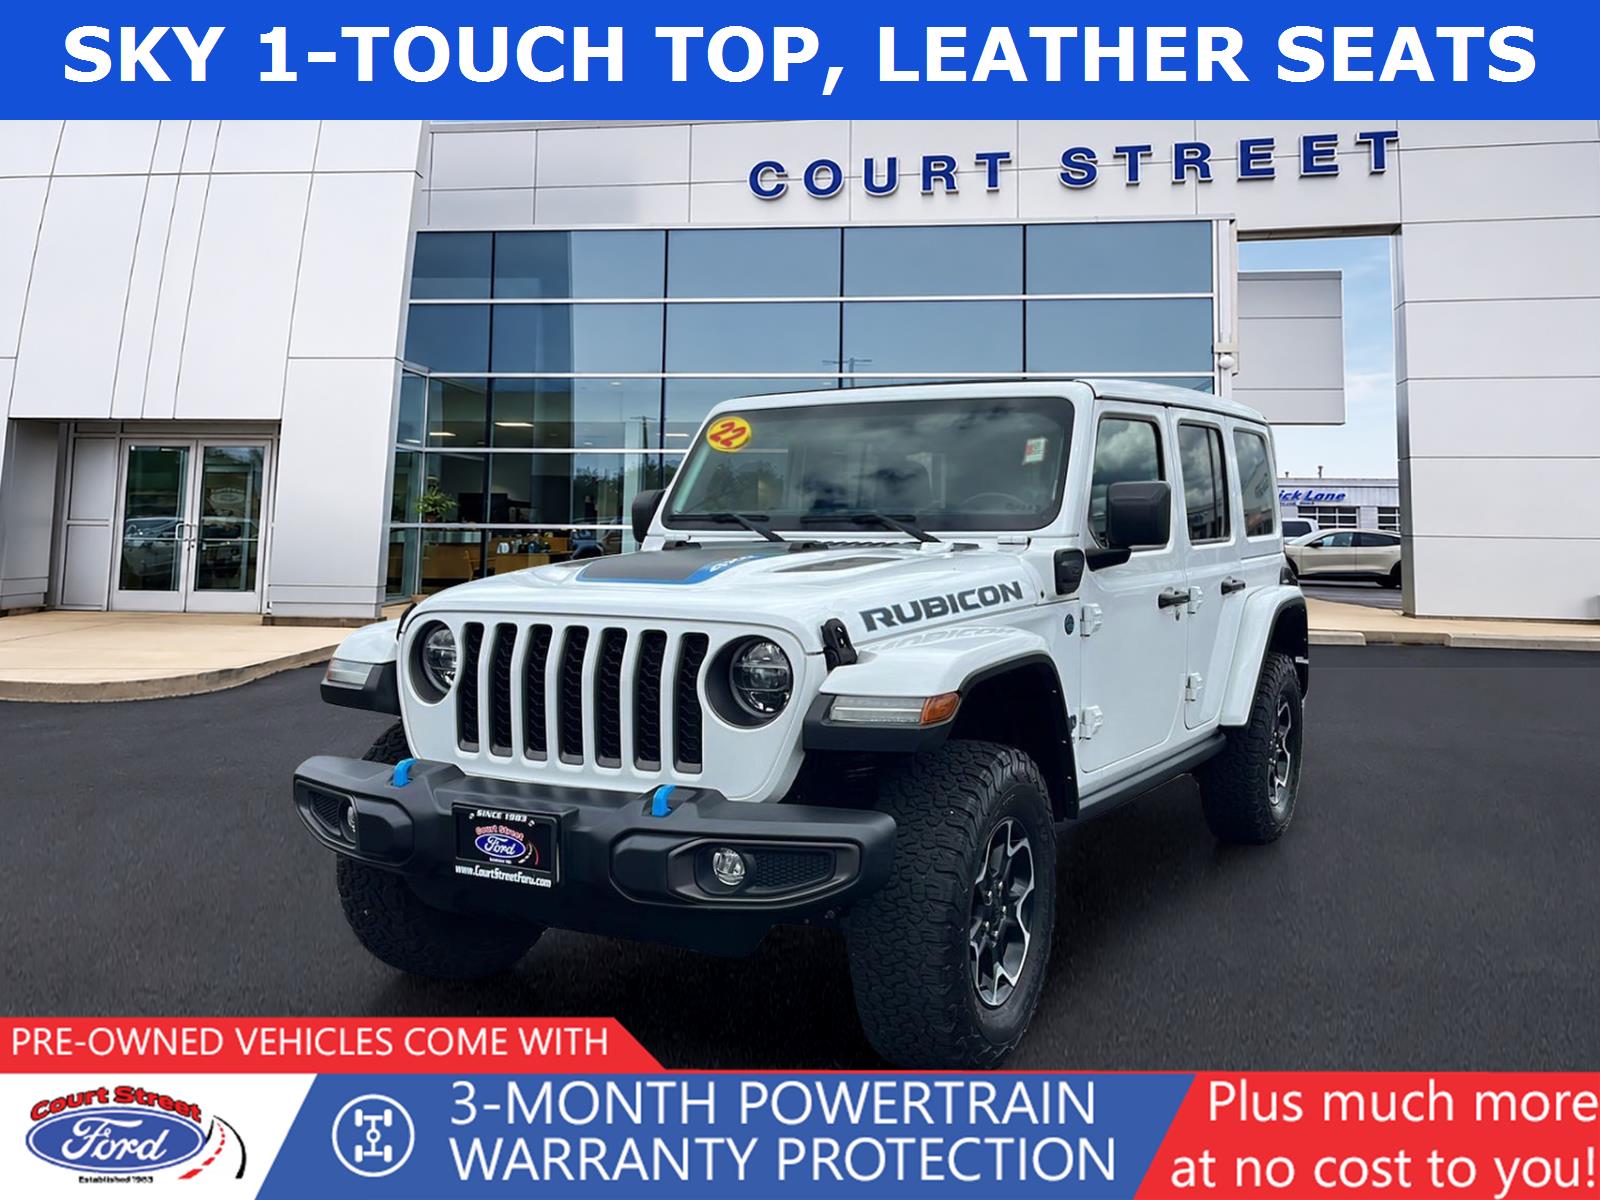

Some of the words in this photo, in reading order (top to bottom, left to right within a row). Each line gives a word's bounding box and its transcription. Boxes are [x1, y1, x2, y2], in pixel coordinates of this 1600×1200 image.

[748, 150, 1011, 200] COURT
[1060, 130, 1400, 189] STREET
[710, 421, 747, 447] 22
[1303, 490, 1346, 501] Lane
[859, 580, 1024, 633] RUBICON
[476, 809, 502, 820] SINCE
[484, 835, 517, 856] Ford
